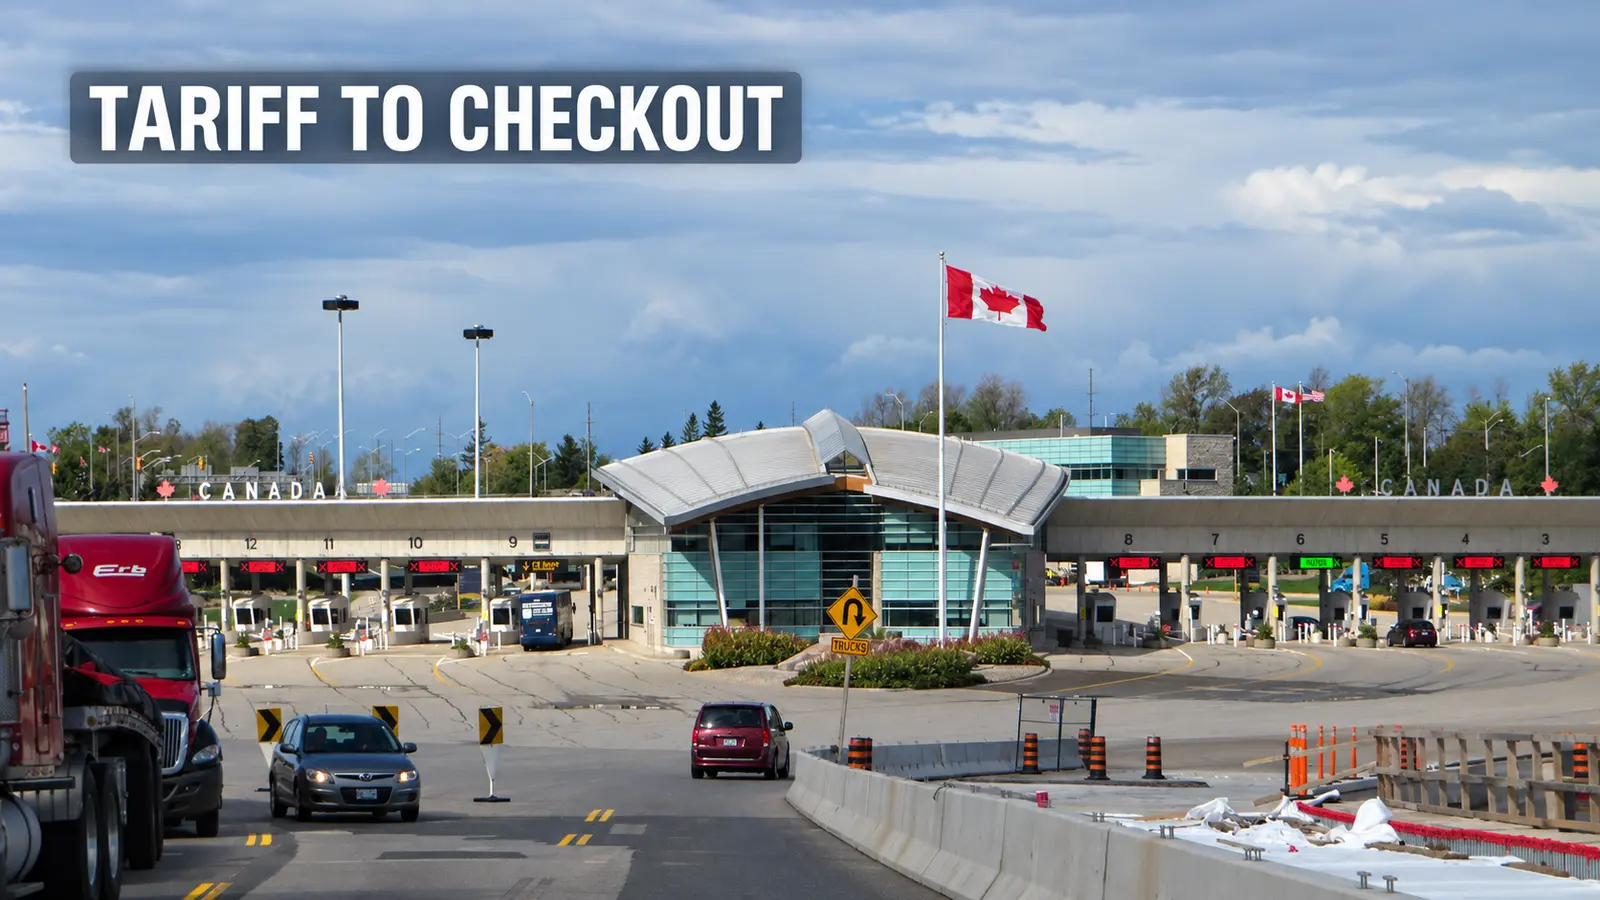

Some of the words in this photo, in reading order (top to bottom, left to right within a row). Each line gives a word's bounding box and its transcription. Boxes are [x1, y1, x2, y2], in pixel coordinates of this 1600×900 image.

[1380, 478, 1514, 497] CANADA
[244, 537, 258, 550] 12
[323, 537, 335, 550] 11
[408, 536, 423, 549] 10
[508, 535, 518, 549] 9
[1123, 533, 1133, 546] 8
[1211, 533, 1220, 546] 7
[1296, 533, 1305, 546] 6
[1380, 533, 1389, 545] 5
[1461, 533, 1470, 545] 4
[1542, 533, 1550, 545] 3
[93, 563, 147, 577] Erb
[834, 639, 867, 653] TRUCKS
